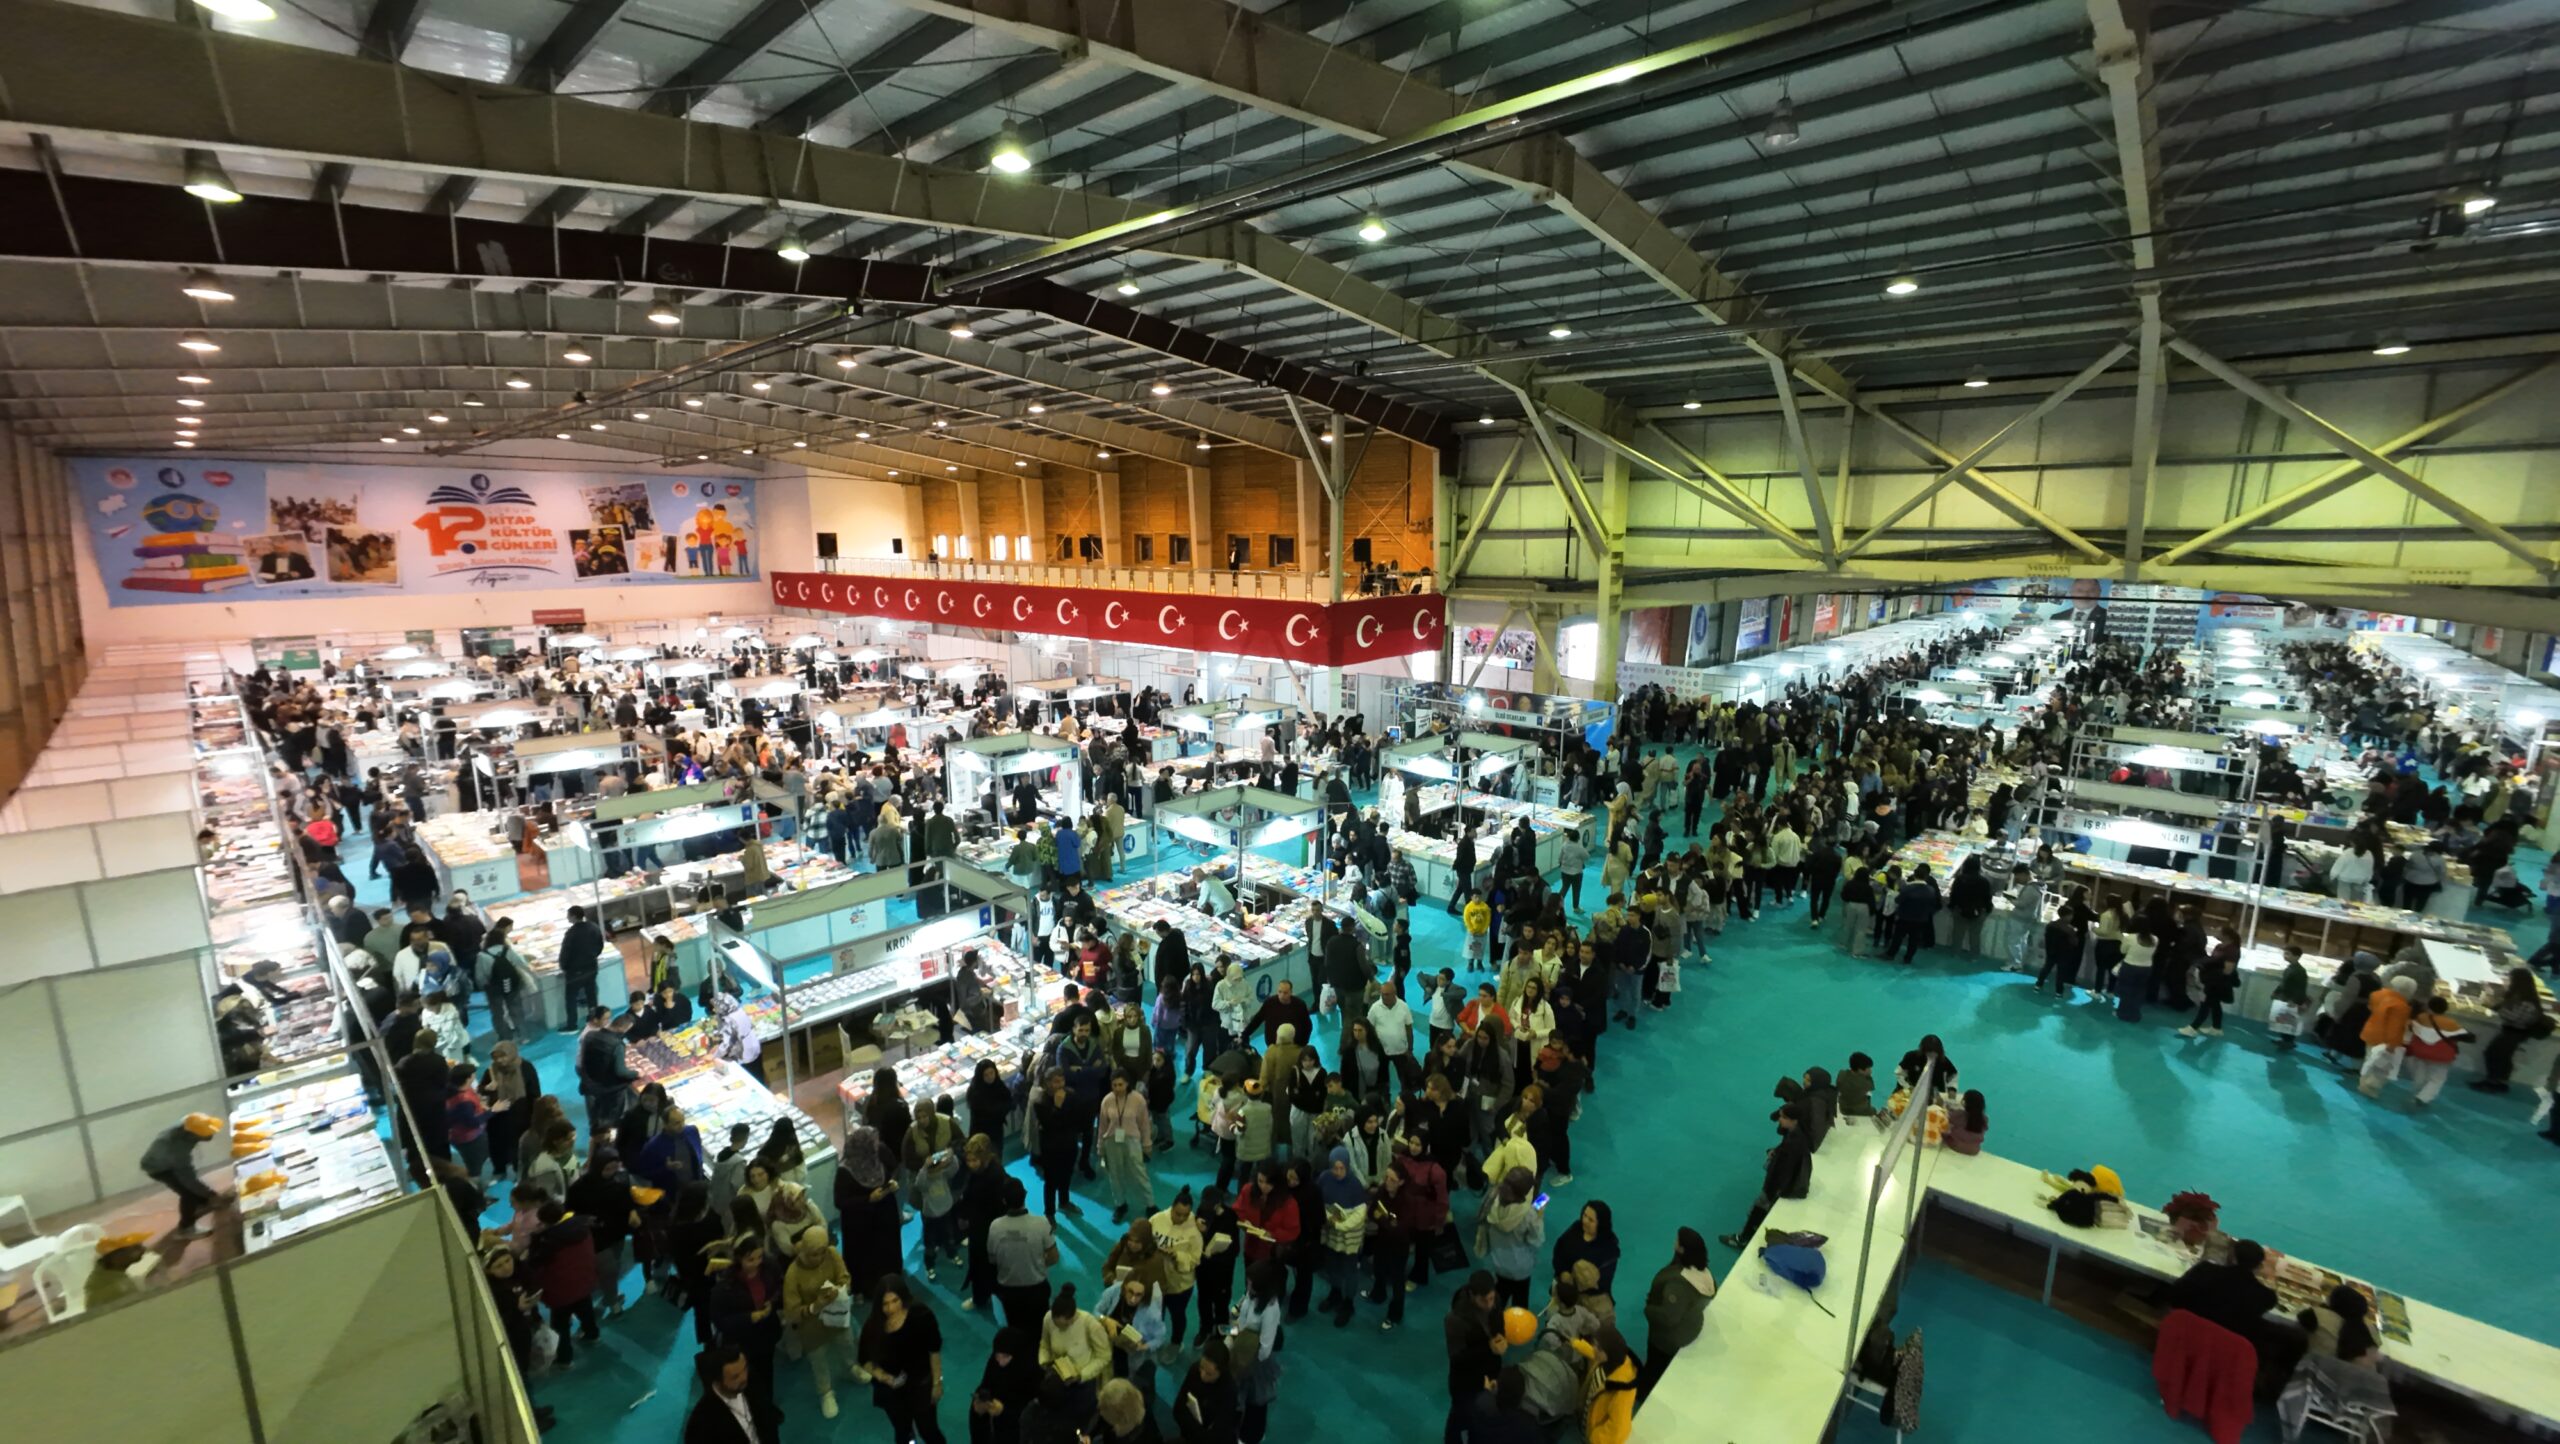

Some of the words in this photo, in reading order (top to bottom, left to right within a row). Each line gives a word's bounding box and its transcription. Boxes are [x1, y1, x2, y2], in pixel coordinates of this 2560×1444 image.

[488, 514, 536, 525] KİTAP
[490, 526, 553, 537] KÜLTÜR
[491, 539, 558, 550] GÜNLERİ
